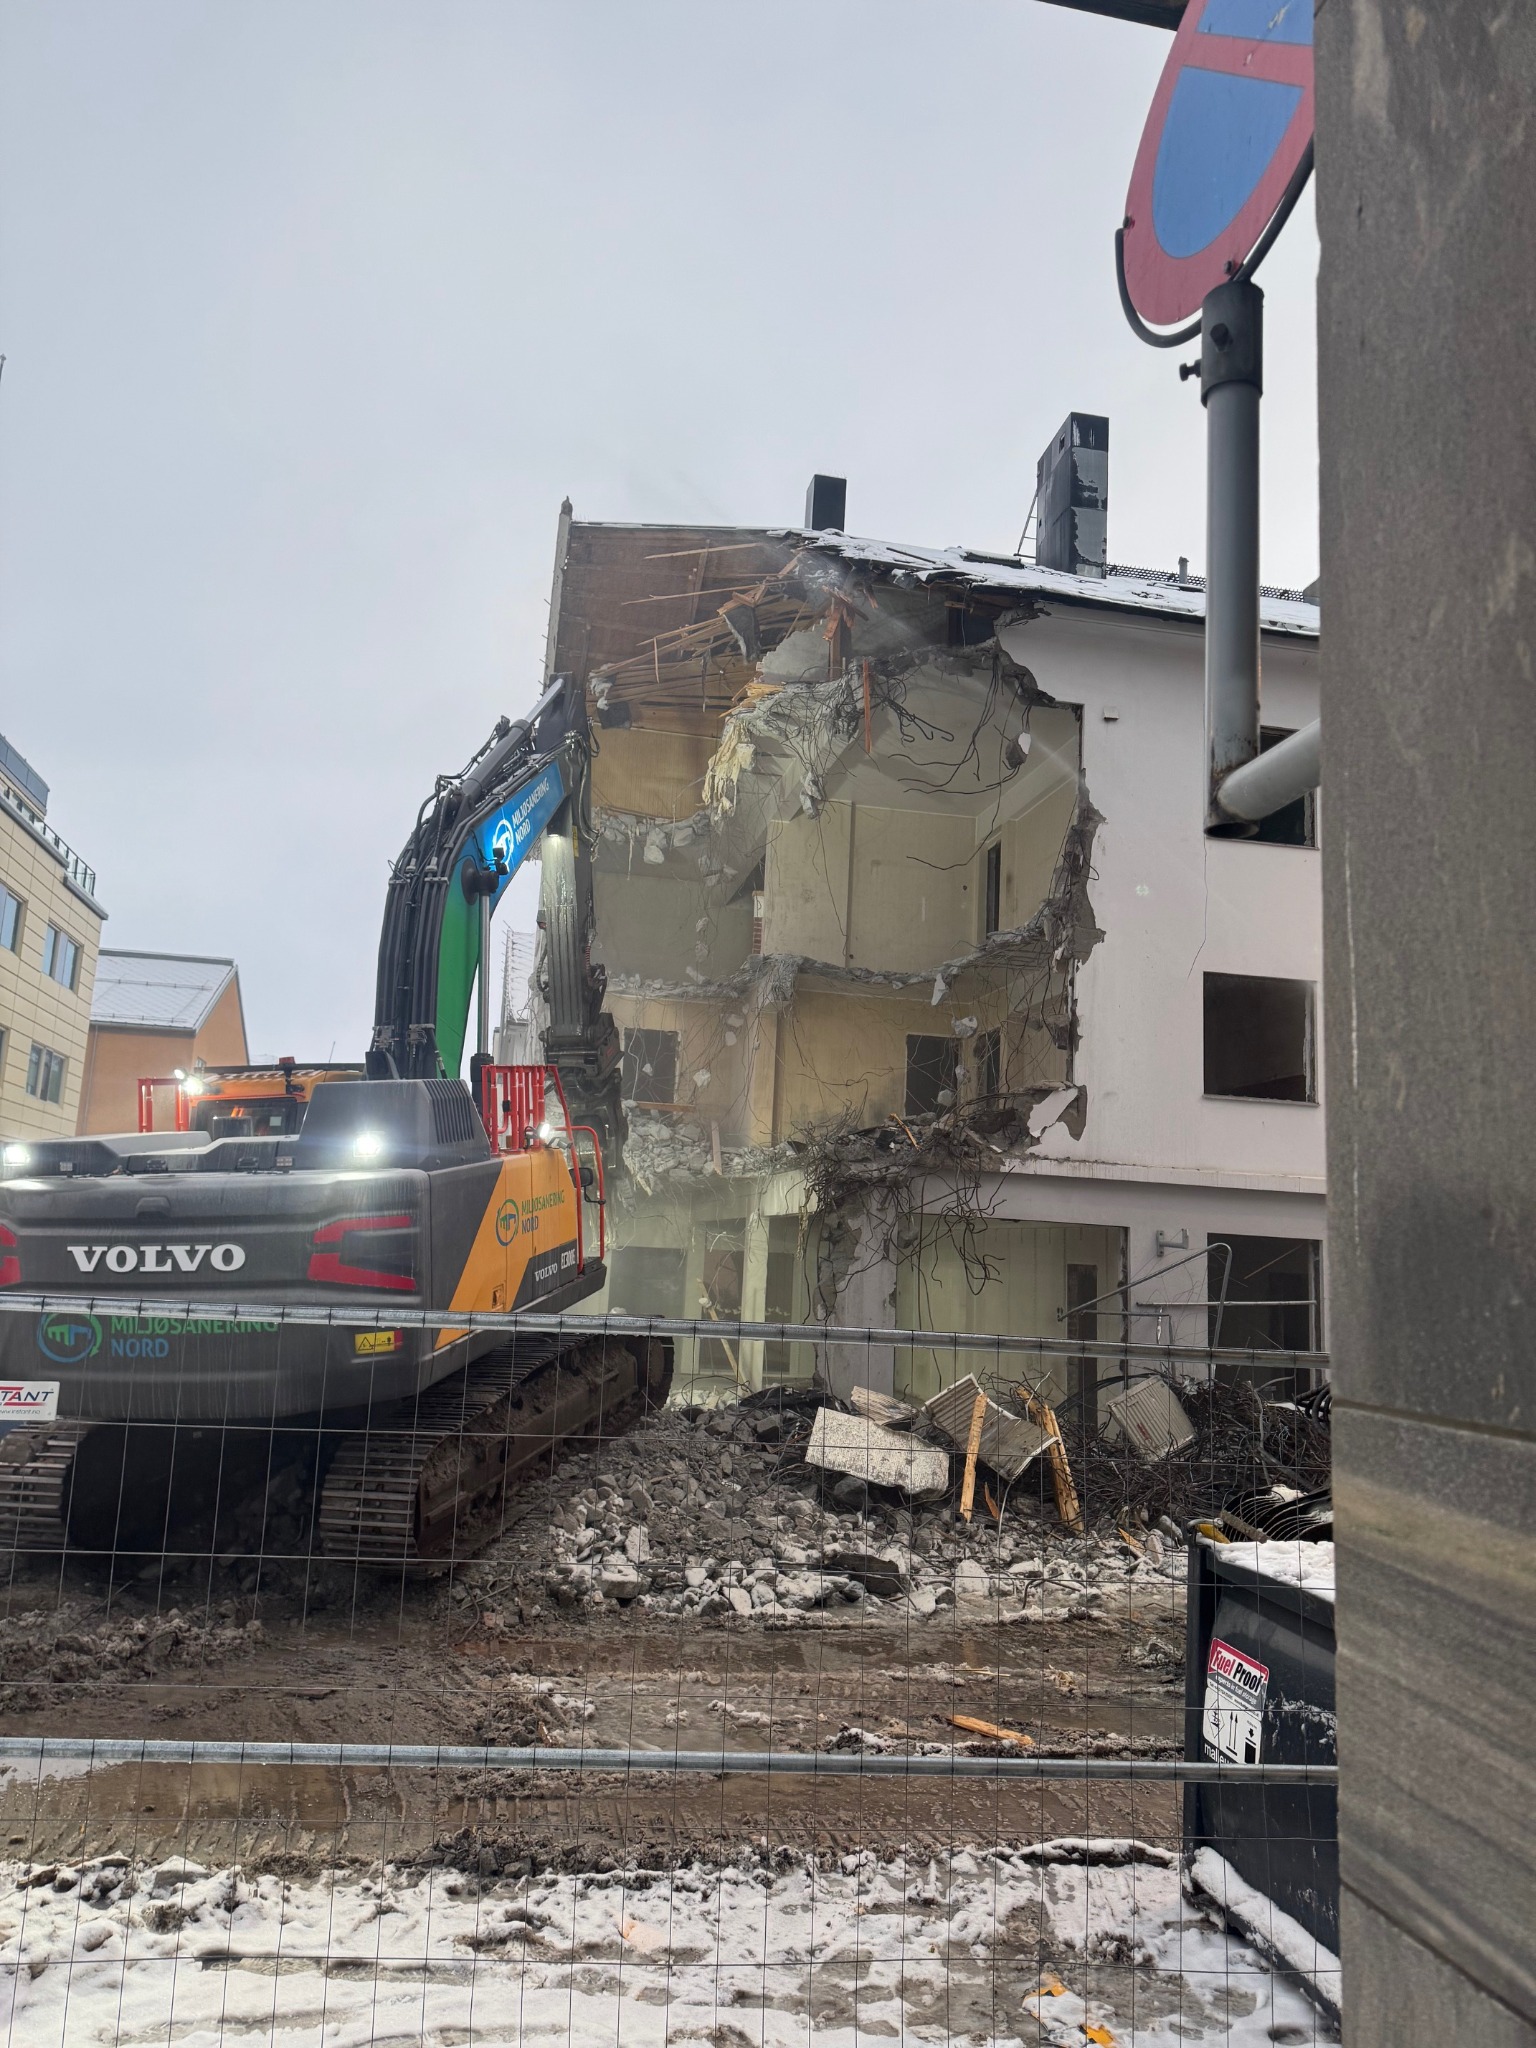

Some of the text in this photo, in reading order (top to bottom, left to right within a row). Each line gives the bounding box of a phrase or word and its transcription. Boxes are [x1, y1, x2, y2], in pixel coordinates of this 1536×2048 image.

[515, 818, 531, 845] NORD
[521, 1215, 539, 1235] NORD
[67, 1243, 246, 1273] VOLVO
[534, 1262, 558, 1282] VOLVO
[110, 1337, 170, 1359] NORD
[1, 1390, 54, 1402] TANT
[1212, 1649, 1264, 1693] Fuel Proof
